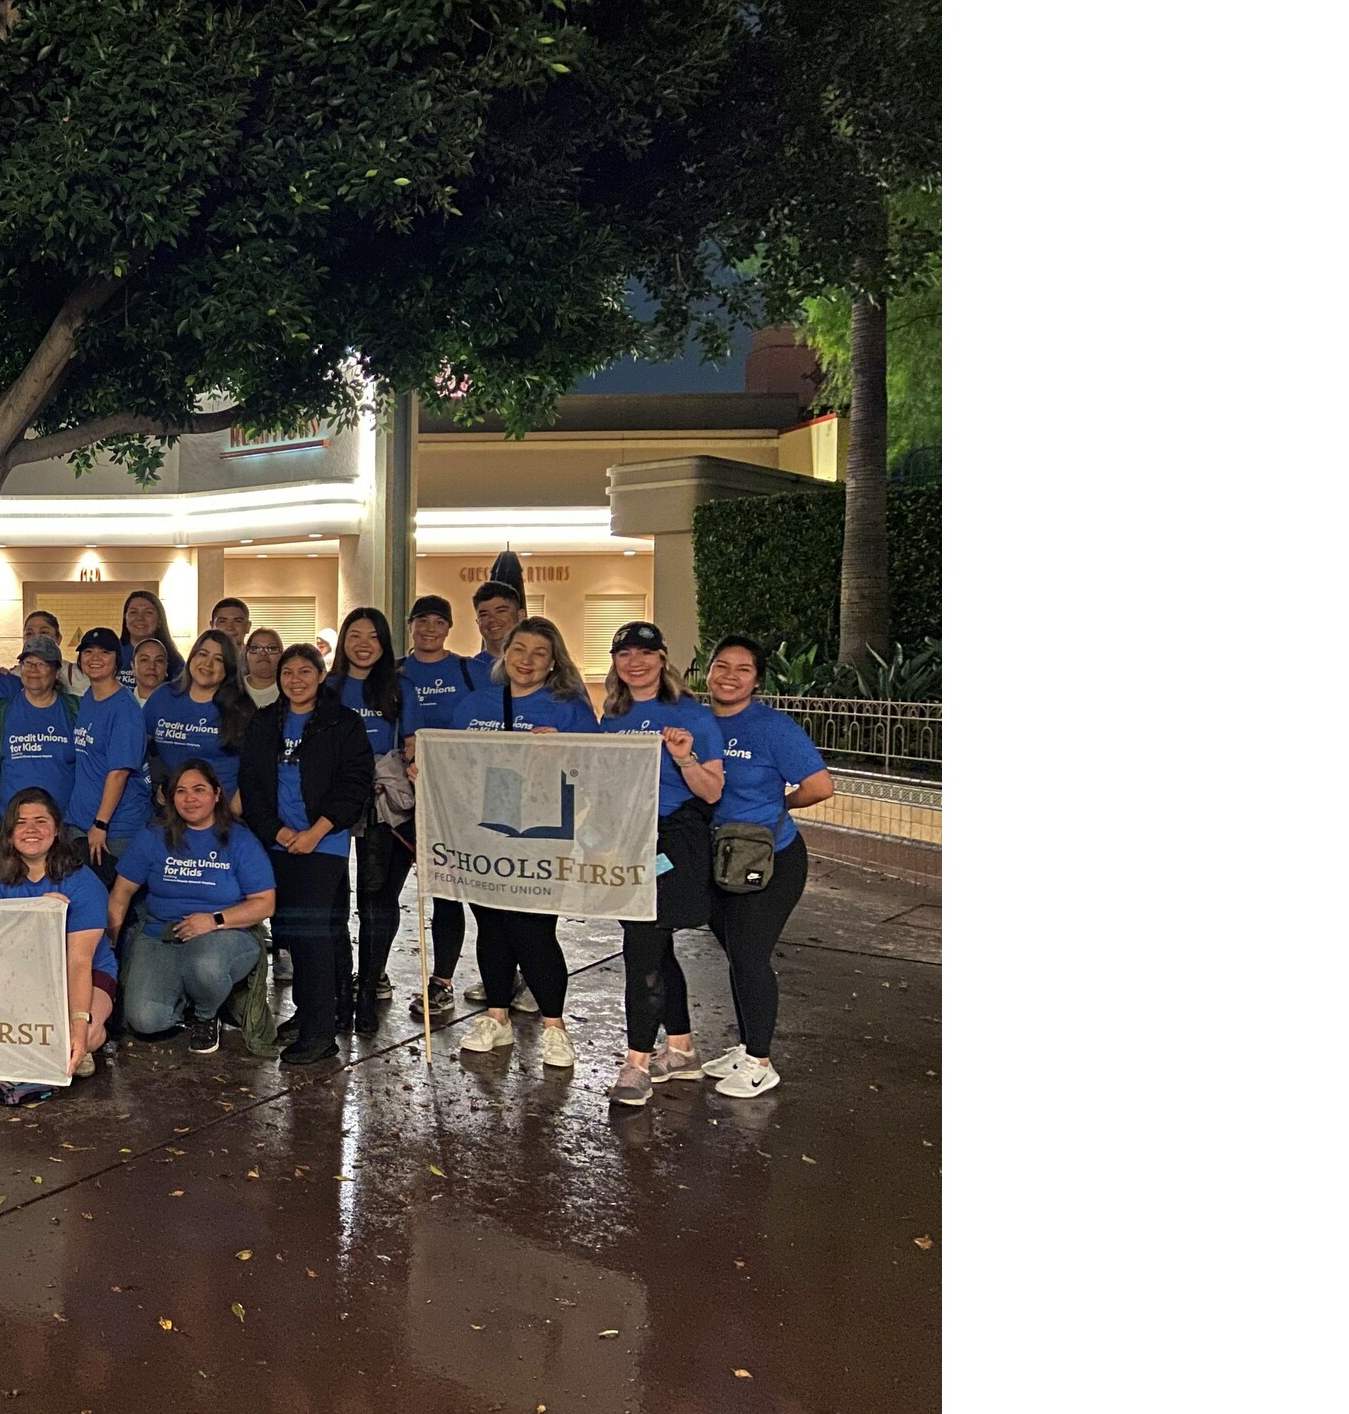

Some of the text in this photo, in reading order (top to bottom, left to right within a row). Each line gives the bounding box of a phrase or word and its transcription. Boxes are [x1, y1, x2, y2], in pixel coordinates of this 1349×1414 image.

[459, 565, 570, 583] GUES ATIONS
[122, 676, 136, 684] Kid
[422, 686, 456, 695] Unions
[157, 718, 219, 735] Credit Unions
[469, 719, 500, 728] Credit
[9, 733, 68, 744] Credit Unions
[154, 728, 187, 740] for Kids
[10, 743, 42, 753] for Kids
[723, 748, 752, 760] ions
[165, 857, 231, 870] Credit Unions
[164, 865, 202, 877] for Kids
[434, 872, 552, 896] FEDAL CREDIT UNION
